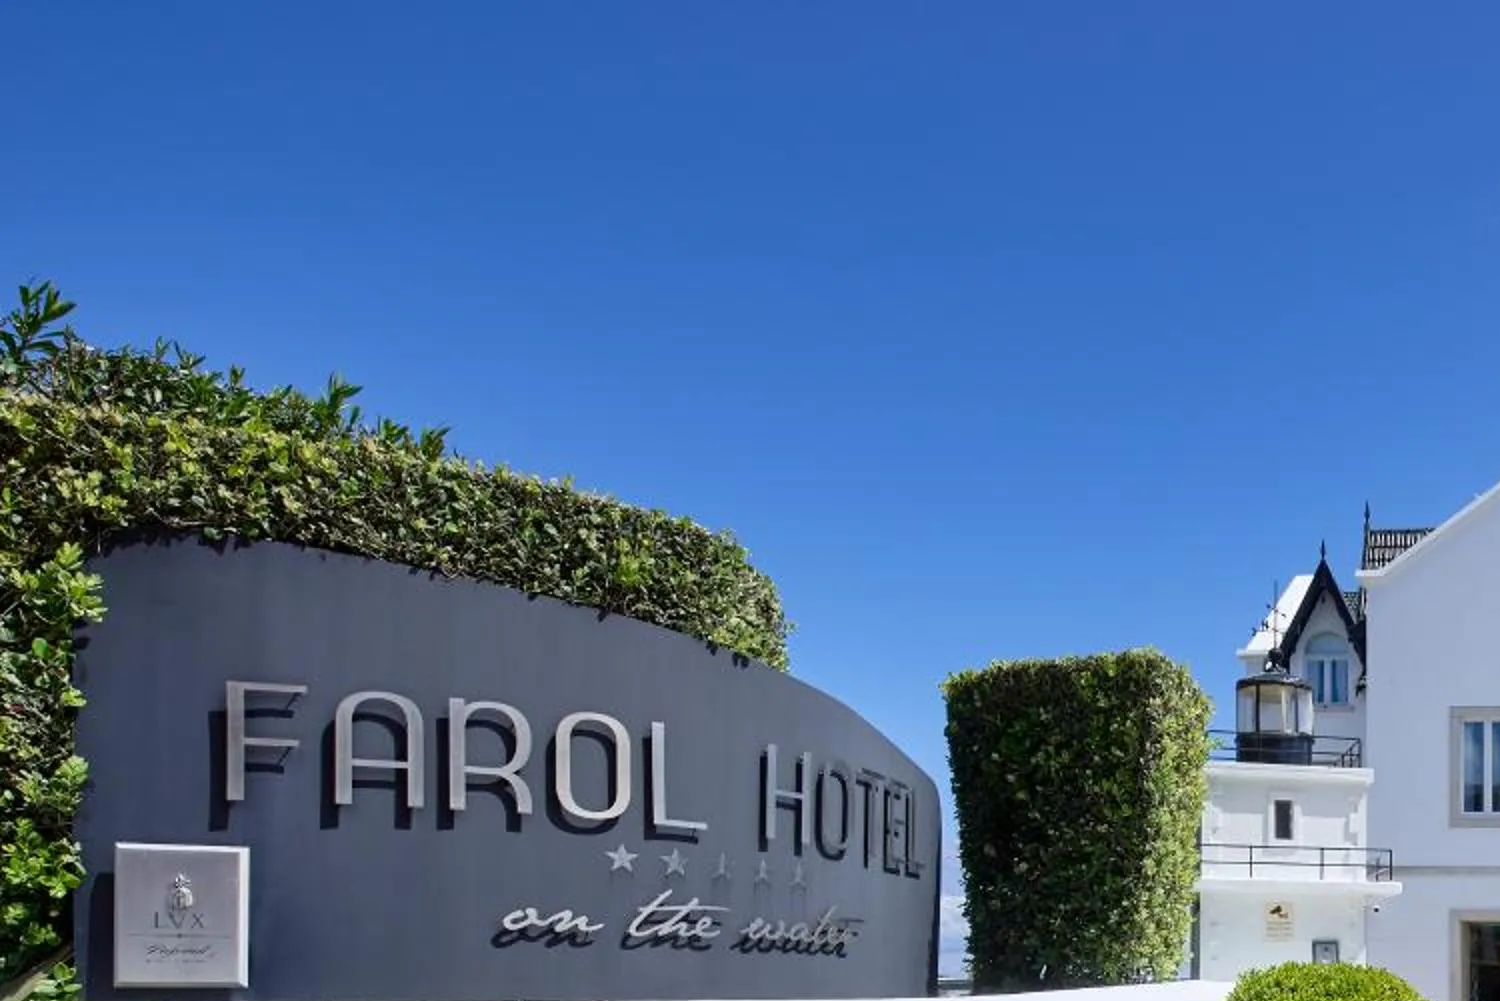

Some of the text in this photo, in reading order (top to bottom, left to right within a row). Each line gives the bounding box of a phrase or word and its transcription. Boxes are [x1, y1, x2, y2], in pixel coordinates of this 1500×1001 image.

[226, 680, 926, 872] FAROL HOTEL
[502, 907, 604, 933] on
[628, 888, 732, 939] the
